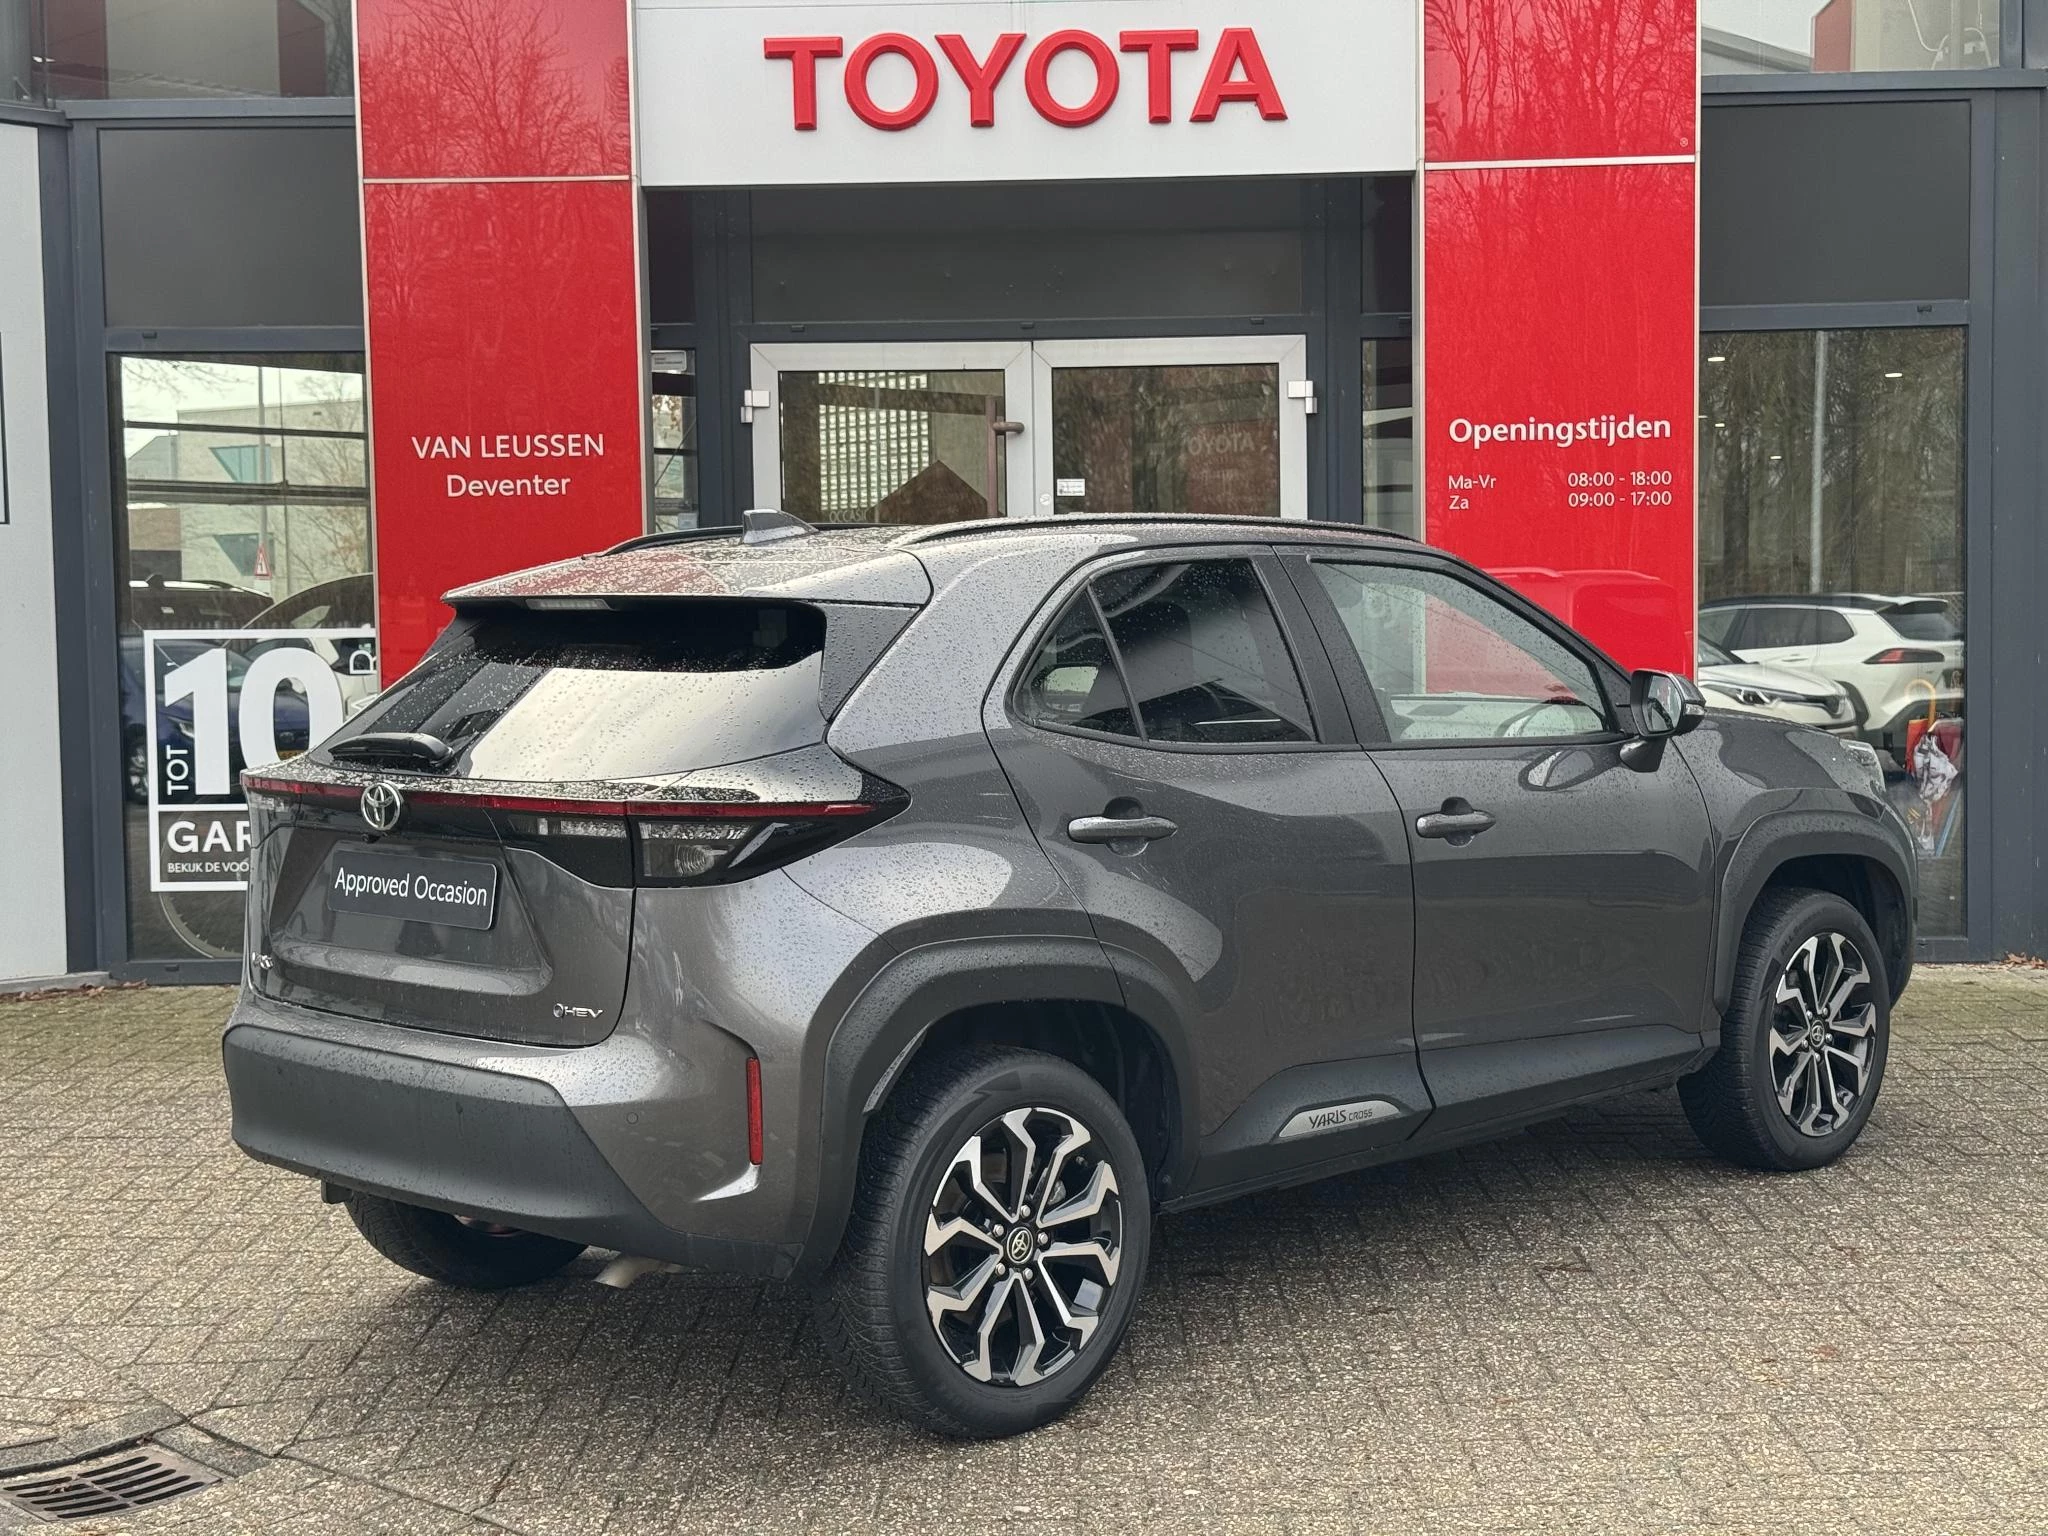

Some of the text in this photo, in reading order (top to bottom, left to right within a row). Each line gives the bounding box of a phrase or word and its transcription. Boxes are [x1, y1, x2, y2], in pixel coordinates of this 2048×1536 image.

[763, 27, 1288, 131] TOYOTA
[1449, 414, 1671, 449] Openingstijden
[411, 433, 605, 459] VAN LEUSSEN
[447, 475, 571, 498] Deventer
[1447, 475, 1497, 490] Ma-Vr
[1567, 472, 1615, 487] 08:00
[1630, 471, 1672, 486] 18:00
[1448, 496, 1469, 510] Za
[1567, 492, 1615, 507] 09:00
[1630, 491, 1672, 506] 17:00
[165, 647, 344, 796] 10
[166, 745, 188, 796] TOT
[167, 862, 204, 872] BEKIJK
[205, 862, 220, 872] DE
[334, 867, 487, 906] Approved Occasion
[564, 1006, 603, 1018] HEV
[1309, 1109, 1373, 1129] YARIS CROSS
